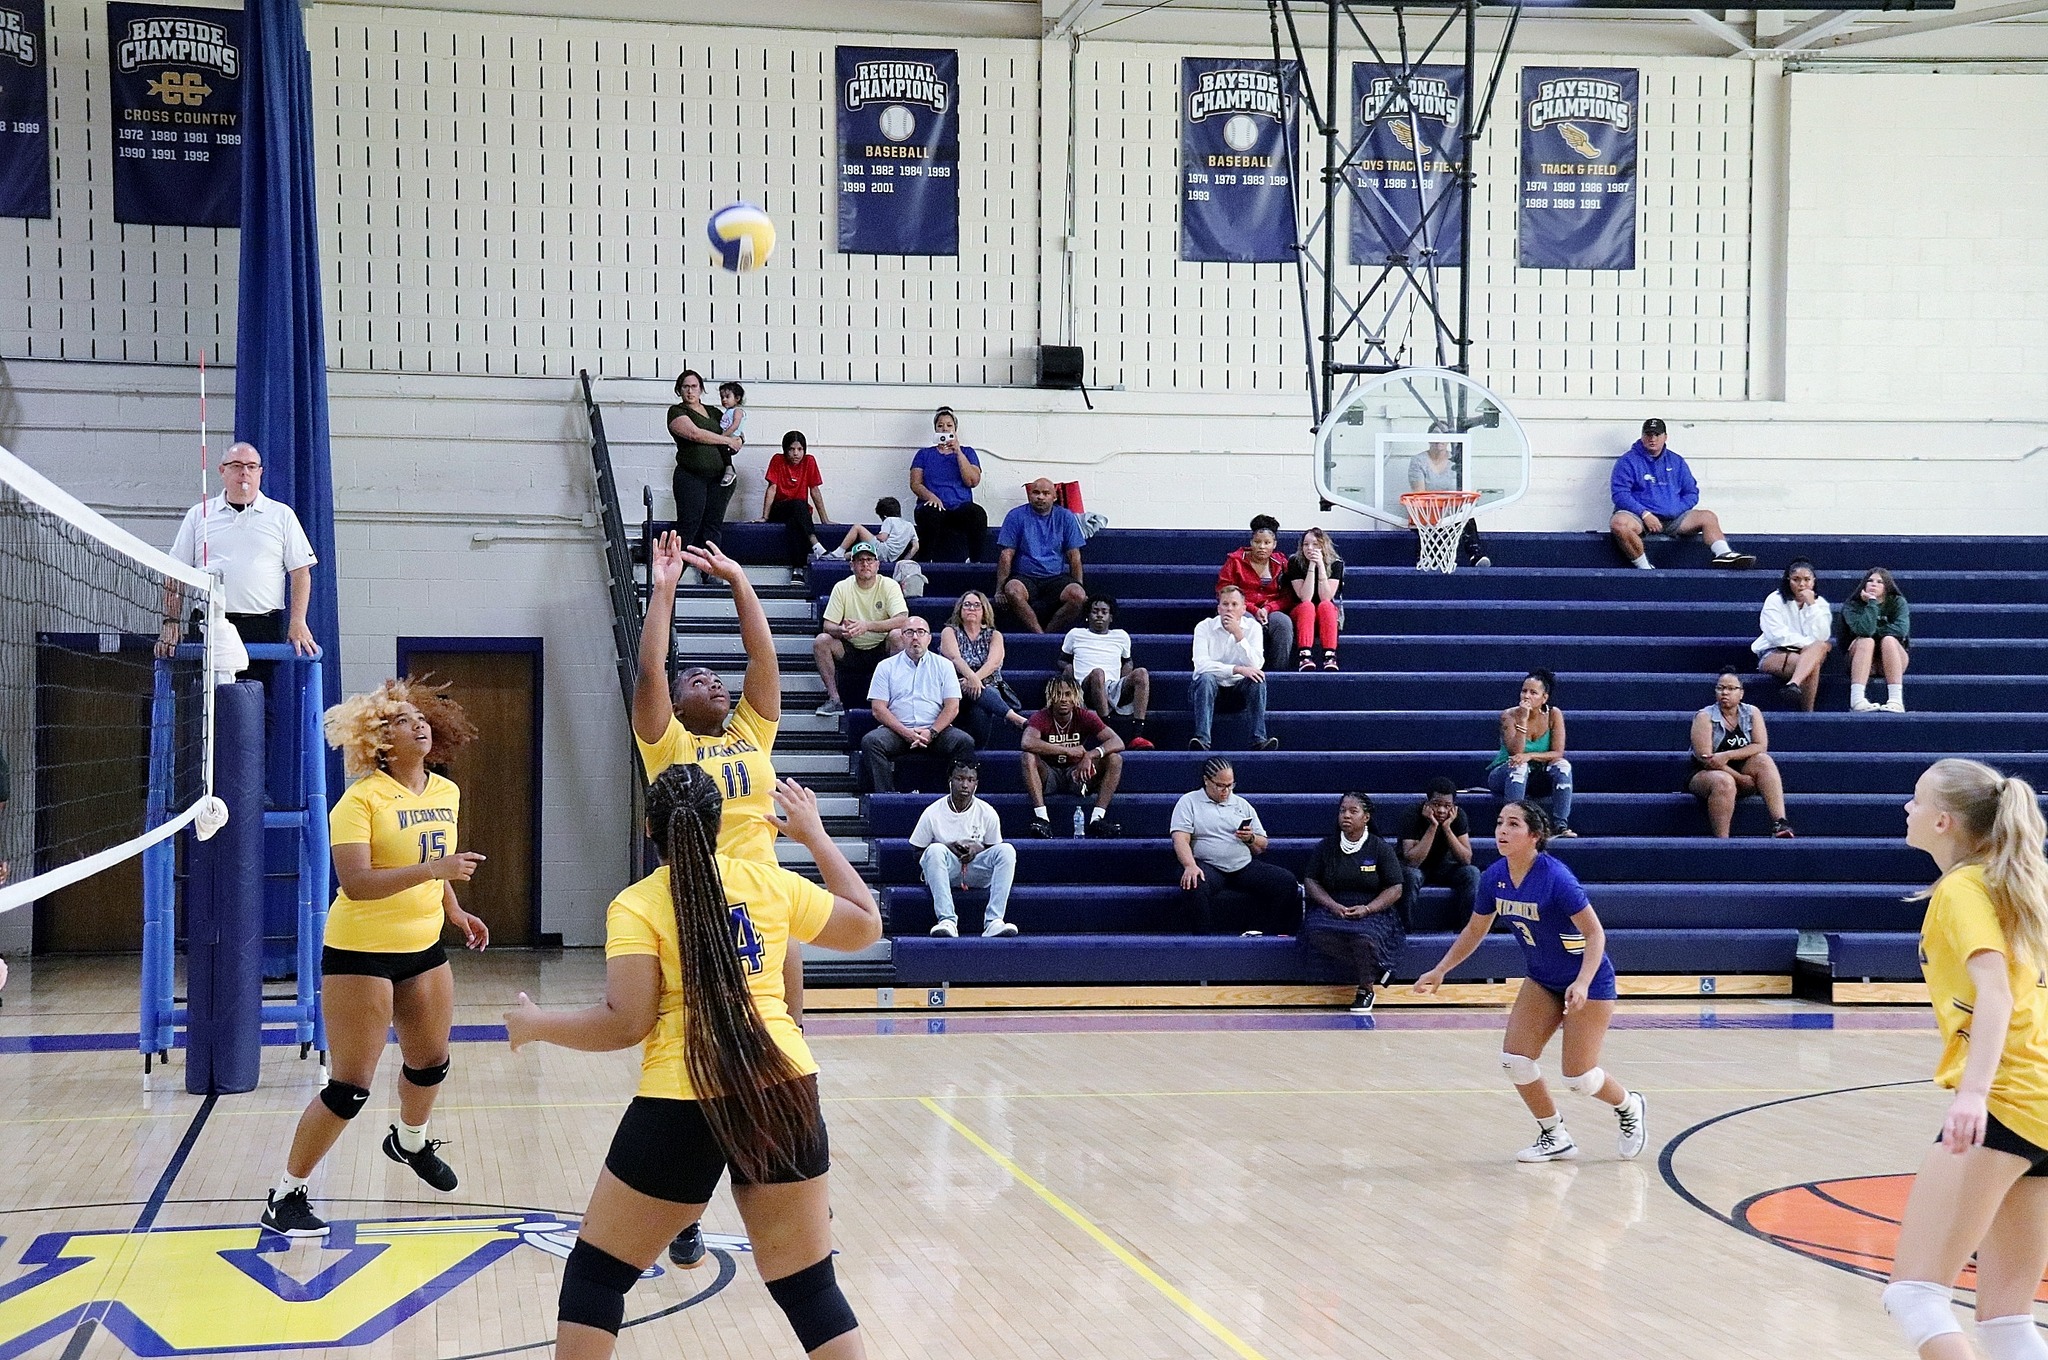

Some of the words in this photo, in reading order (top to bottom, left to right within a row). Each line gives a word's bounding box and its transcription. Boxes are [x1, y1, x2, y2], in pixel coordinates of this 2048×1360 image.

[132, 21, 224, 46] BAYSIDE
[121, 40, 236, 76] CHAMPIONS
[858, 63, 935, 83] REGIONAL
[1202, 73, 1279, 94] BAYSIDE
[1374, 80, 1447, 97] REONAL
[1541, 81, 1620, 100] BAYSIDE
[849, 78, 945, 110] CHAMPIONS
[124, 109, 170, 122] CROSS
[175, 111, 237, 126] COUNTRY
[1531, 98, 1629, 129] CHAMPIONS
[12, 121, 40, 134] 1989
[119, 128, 144, 141] 1972
[151, 131, 178, 142] 1980
[184, 132, 208, 144] 1981
[216, 133, 242, 145] 1989
[119, 147, 146, 159] 1990
[152, 149, 177, 160] 1991
[184, 151, 210, 162] 1992
[865, 145, 930, 159] BASEBALL
[1208, 155, 1273, 168] BASEBALL
[1361, 160, 1384, 171] OYS
[843, 165, 865, 175] 1981
[871, 165, 894, 176] 1982
[900, 166, 923, 176] 1984
[927, 166, 951, 177] 1993
[1541, 163, 1574, 175] TRACK
[1577, 164, 1585, 174] &
[1588, 164, 1617, 176] FIELD
[1188, 173, 1209, 184] 1974
[1214, 174, 1236, 185] 1979
[1242, 175, 1265, 185] 1983
[1384, 178, 1406, 189] 1986
[1411, 179, 1434, 189] 188
[843, 182, 866, 193] 1999
[871, 183, 894, 193] 2001
[1525, 181, 1547, 192] 1974
[1553, 181, 1575, 192] 1980
[1580, 182, 1602, 192] 1986
[1607, 182, 1630, 193] 1987
[1188, 190, 1210, 201] 1993
[1525, 198, 1548, 209] 1988
[1553, 199, 1575, 209] 1989
[1580, 199, 1601, 209] 1991
[1048, 732, 1080, 743] BUILD
[722, 760, 751, 800] 11
[418, 829, 447, 865] 15
[1512, 921, 1536, 947] 3
